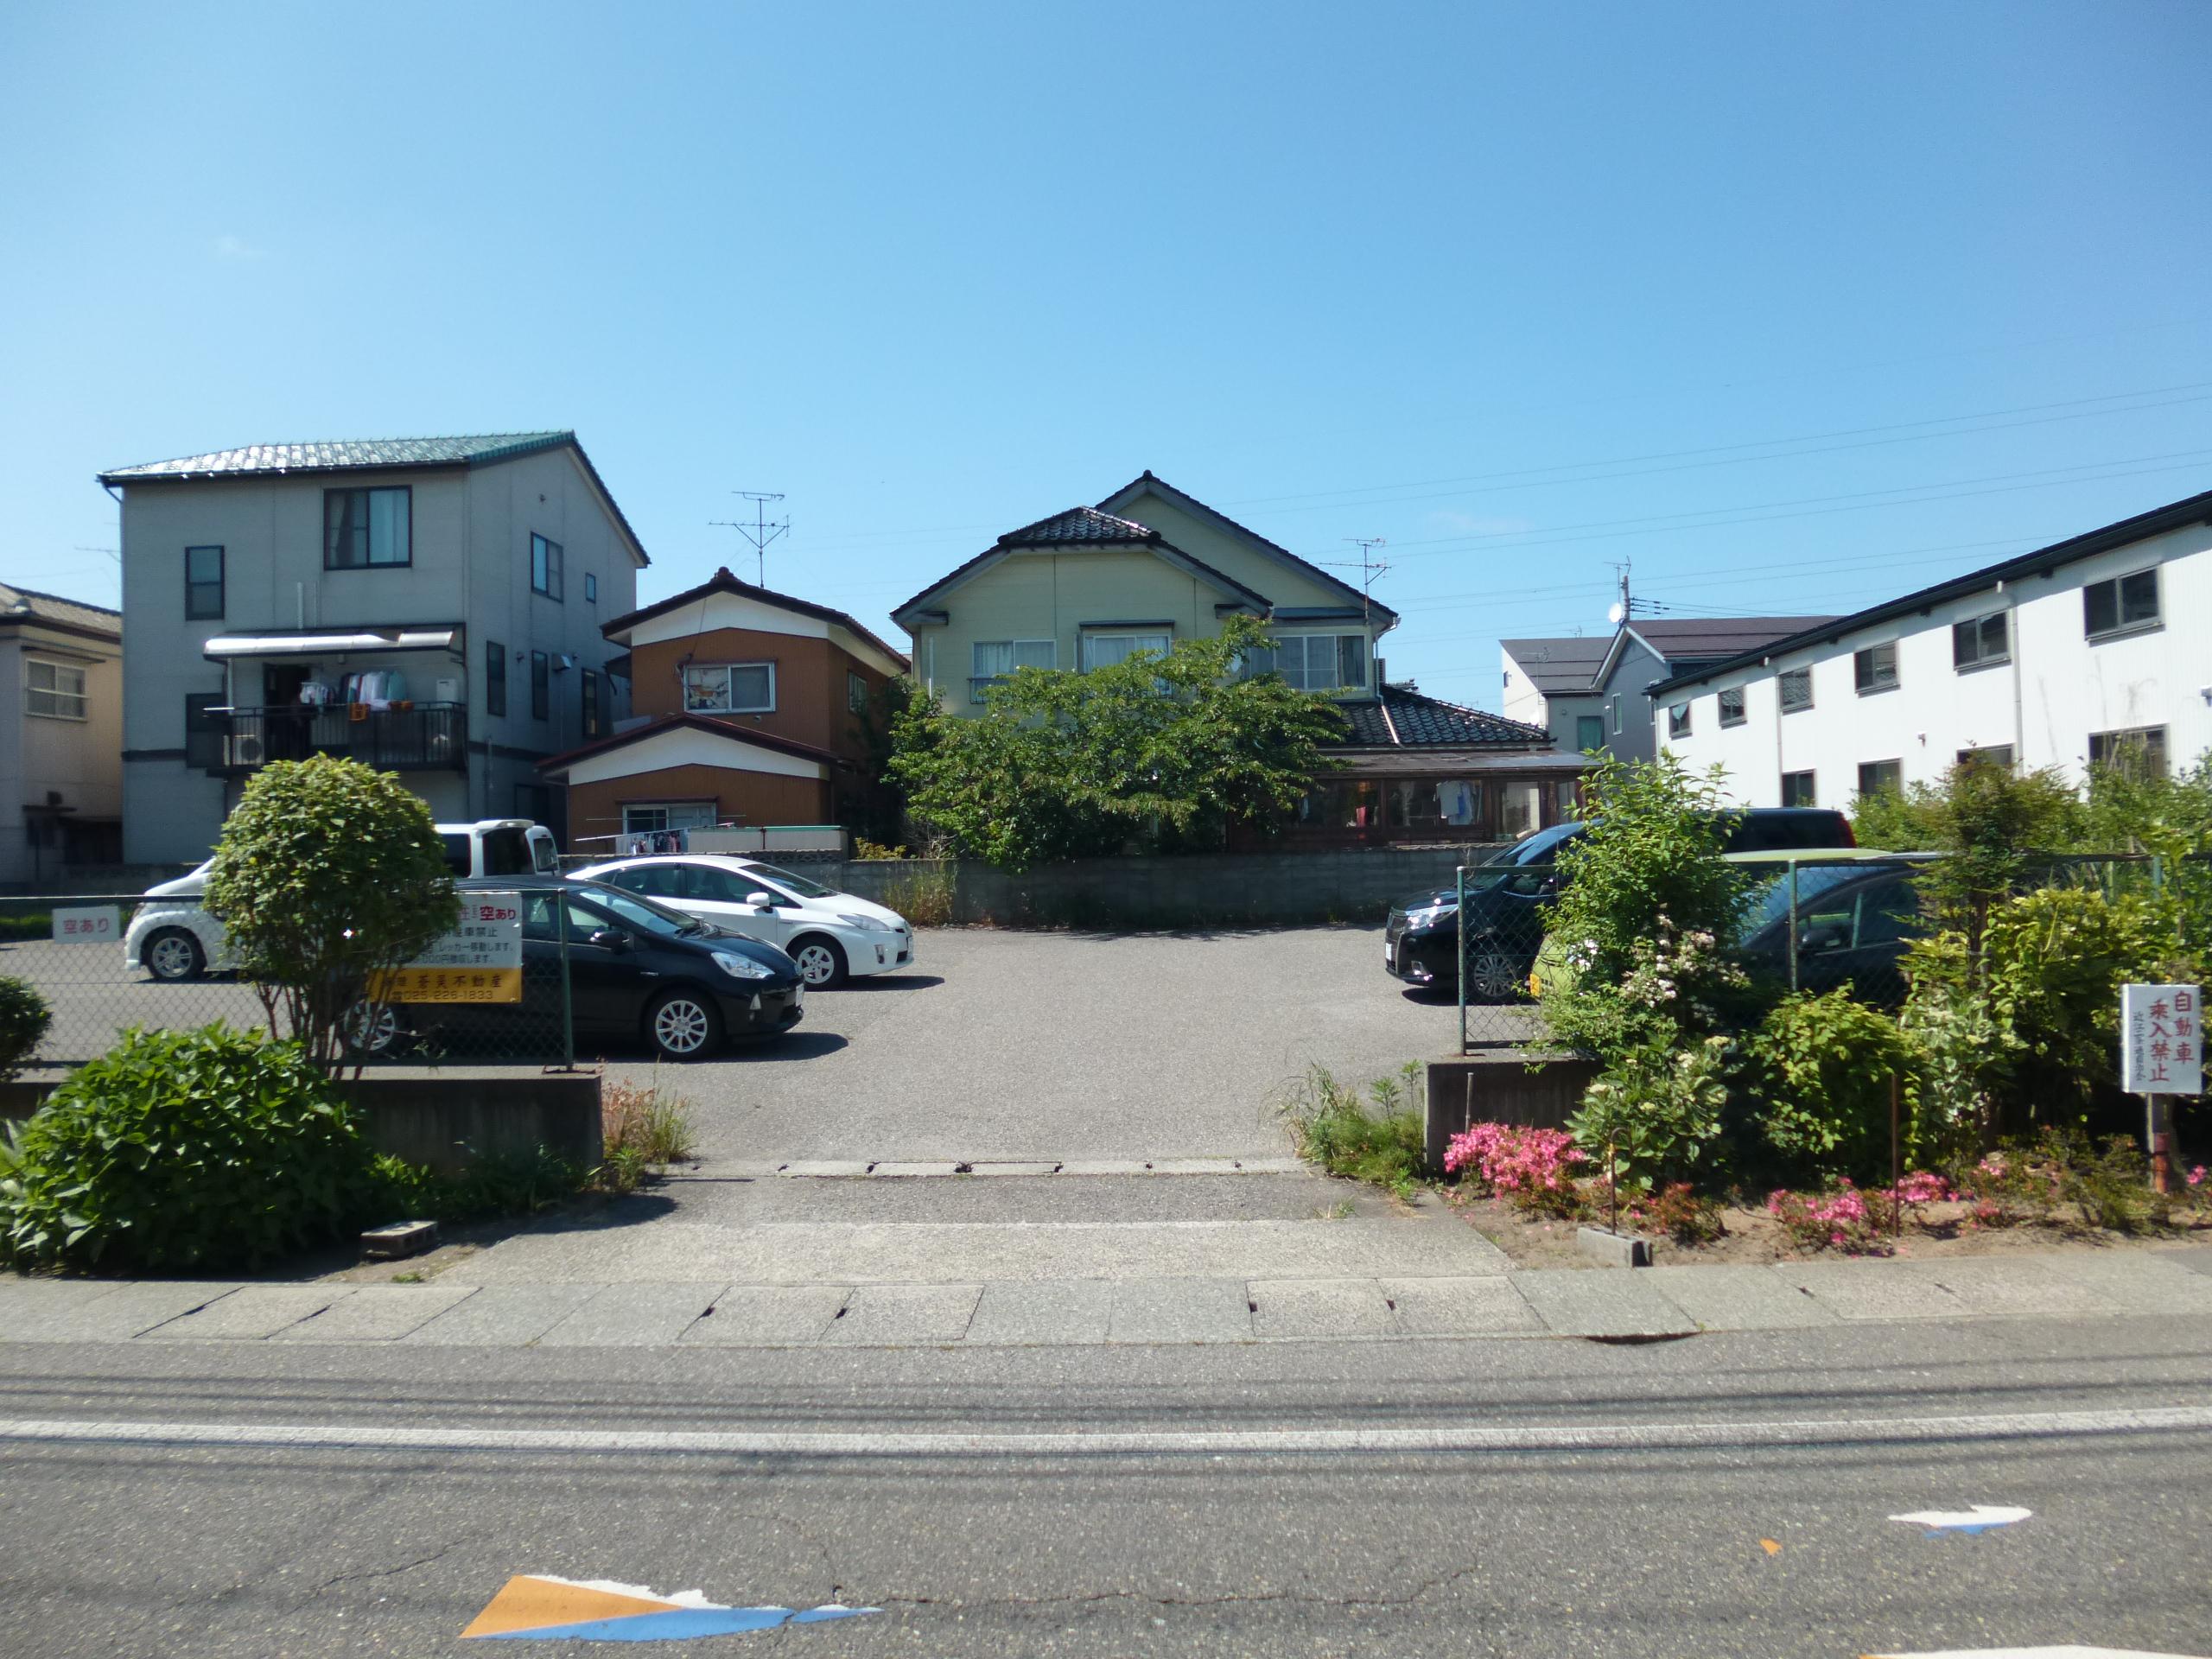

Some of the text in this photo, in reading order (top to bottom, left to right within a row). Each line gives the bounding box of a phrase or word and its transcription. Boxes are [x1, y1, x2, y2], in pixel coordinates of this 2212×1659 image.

[62, 918, 110, 934] 空あり
[480, 906, 516, 921] 空あり
[2149, 997, 2172, 1082] 乗入禁止
[2174, 990, 2194, 1065] 自動車
